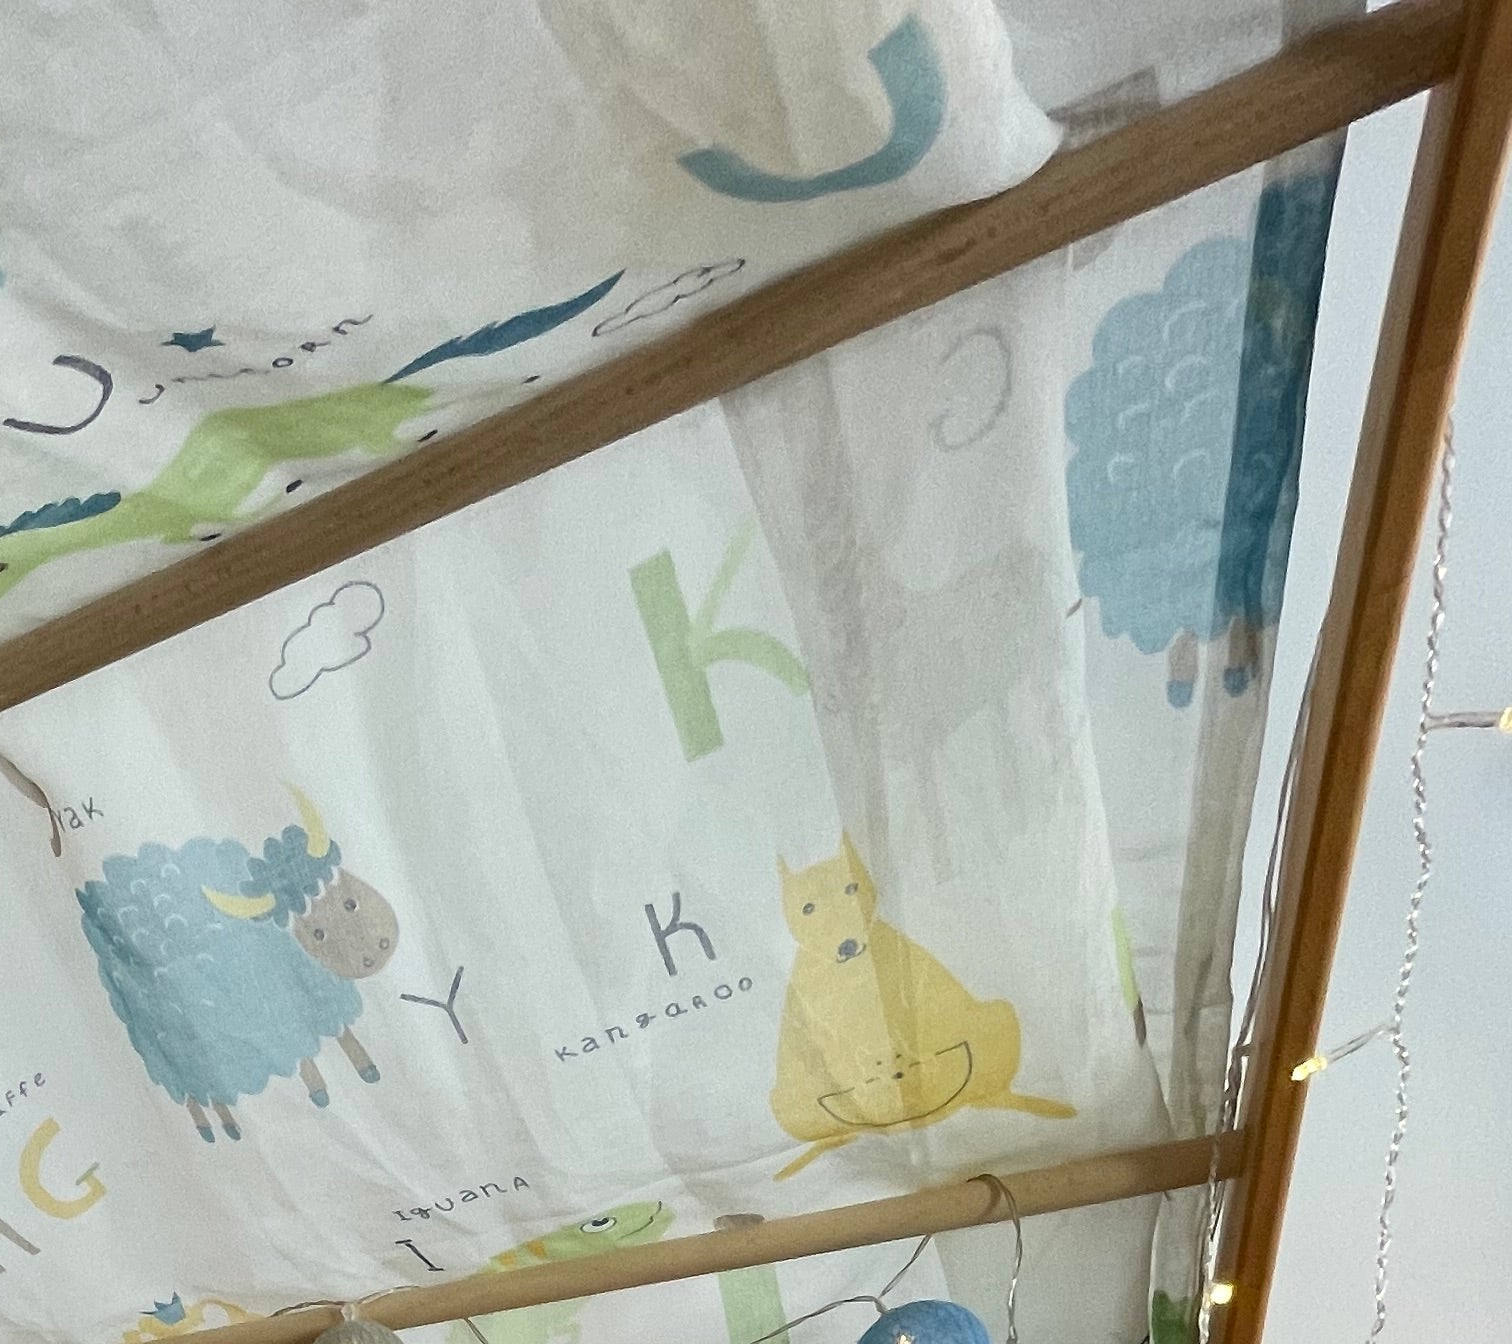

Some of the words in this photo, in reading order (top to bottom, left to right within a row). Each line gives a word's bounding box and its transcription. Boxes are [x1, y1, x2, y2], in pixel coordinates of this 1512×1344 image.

[628, 517, 812, 763] K
[644, 891, 717, 977] K
[399, 965, 469, 1044] Y
[18, 1115, 108, 1220] G
[394, 1238, 446, 1272] I
